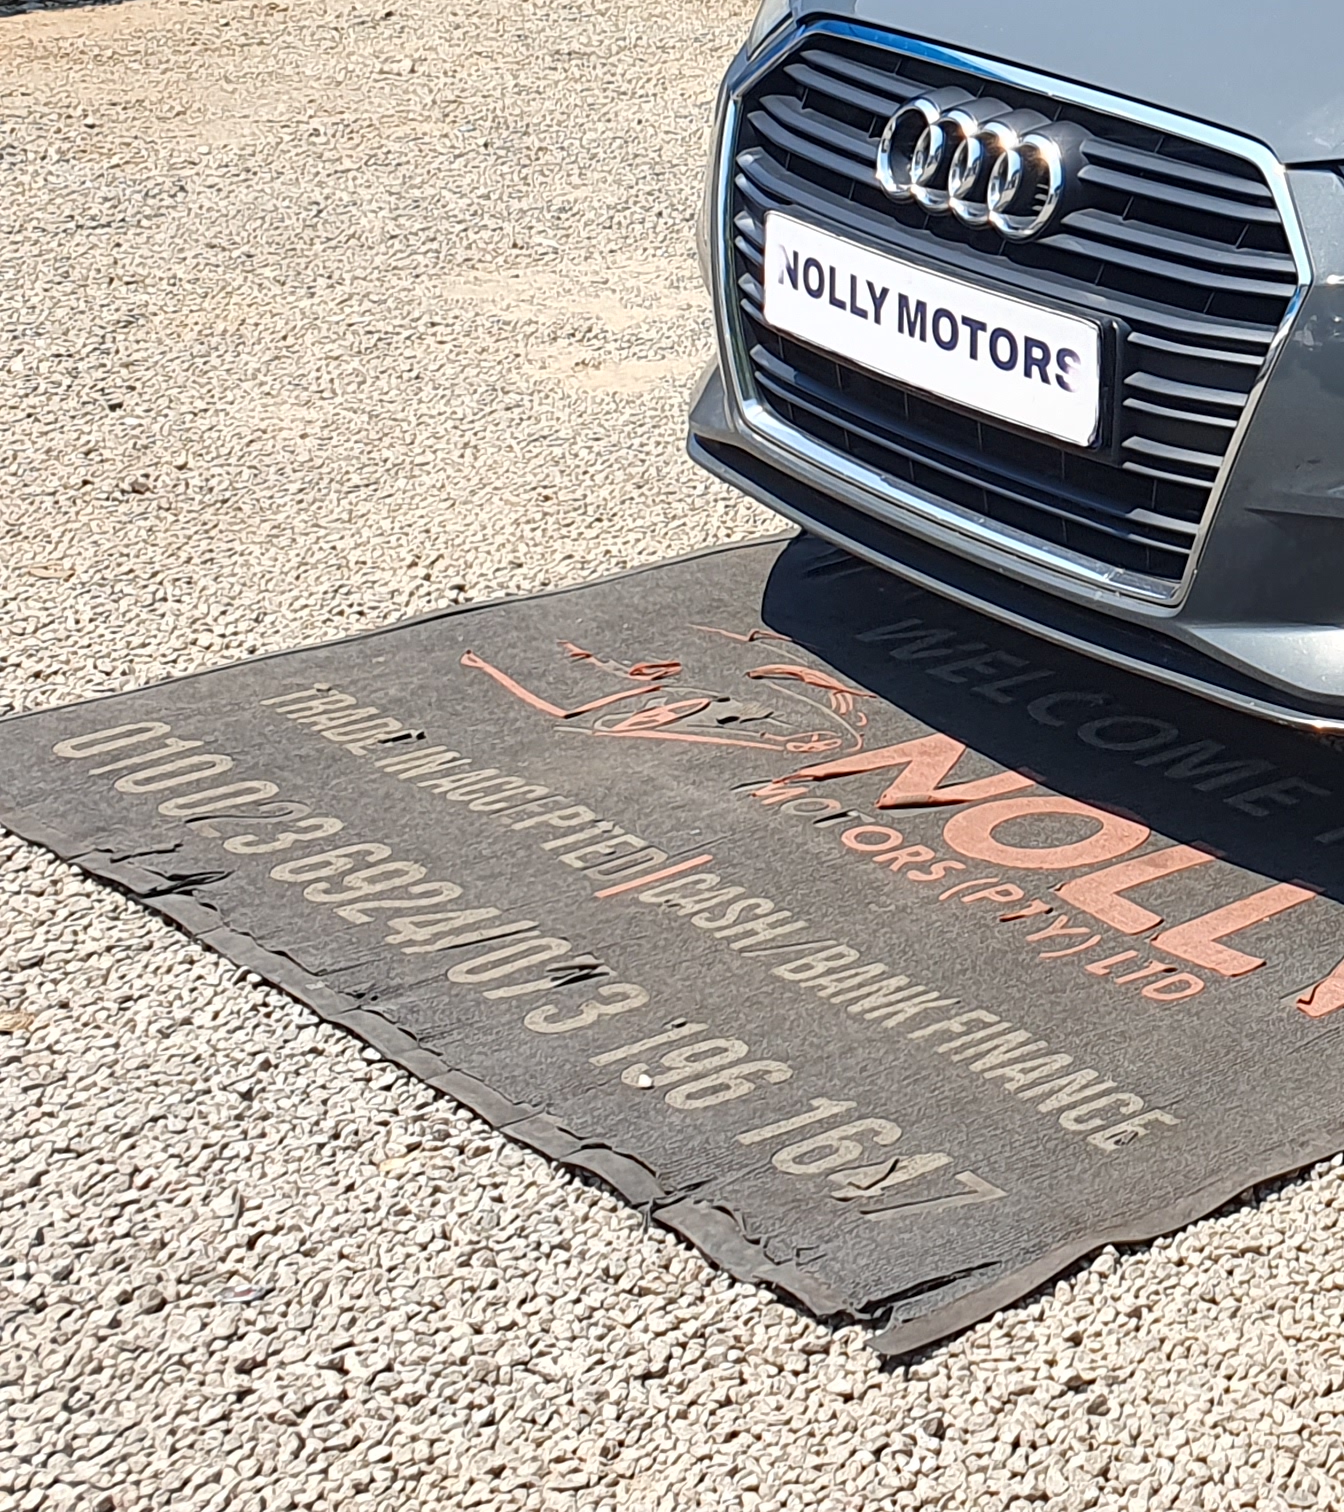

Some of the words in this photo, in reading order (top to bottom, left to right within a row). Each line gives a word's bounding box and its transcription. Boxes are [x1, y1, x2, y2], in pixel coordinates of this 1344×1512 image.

[777, 243, 891, 324] NOLLY
[896, 292, 1083, 394] MOTORS
[853, 618, 1334, 818] WELCOME
[259, 682, 424, 756] TRADE
[374, 745, 472, 780] IN
[907, 1007, 1185, 1152] FINANCE
[733, 780, 967, 883] MOTORS
[937, 877, 1102, 960] (PTY)
[1083, 949, 1206, 1002] LTD
